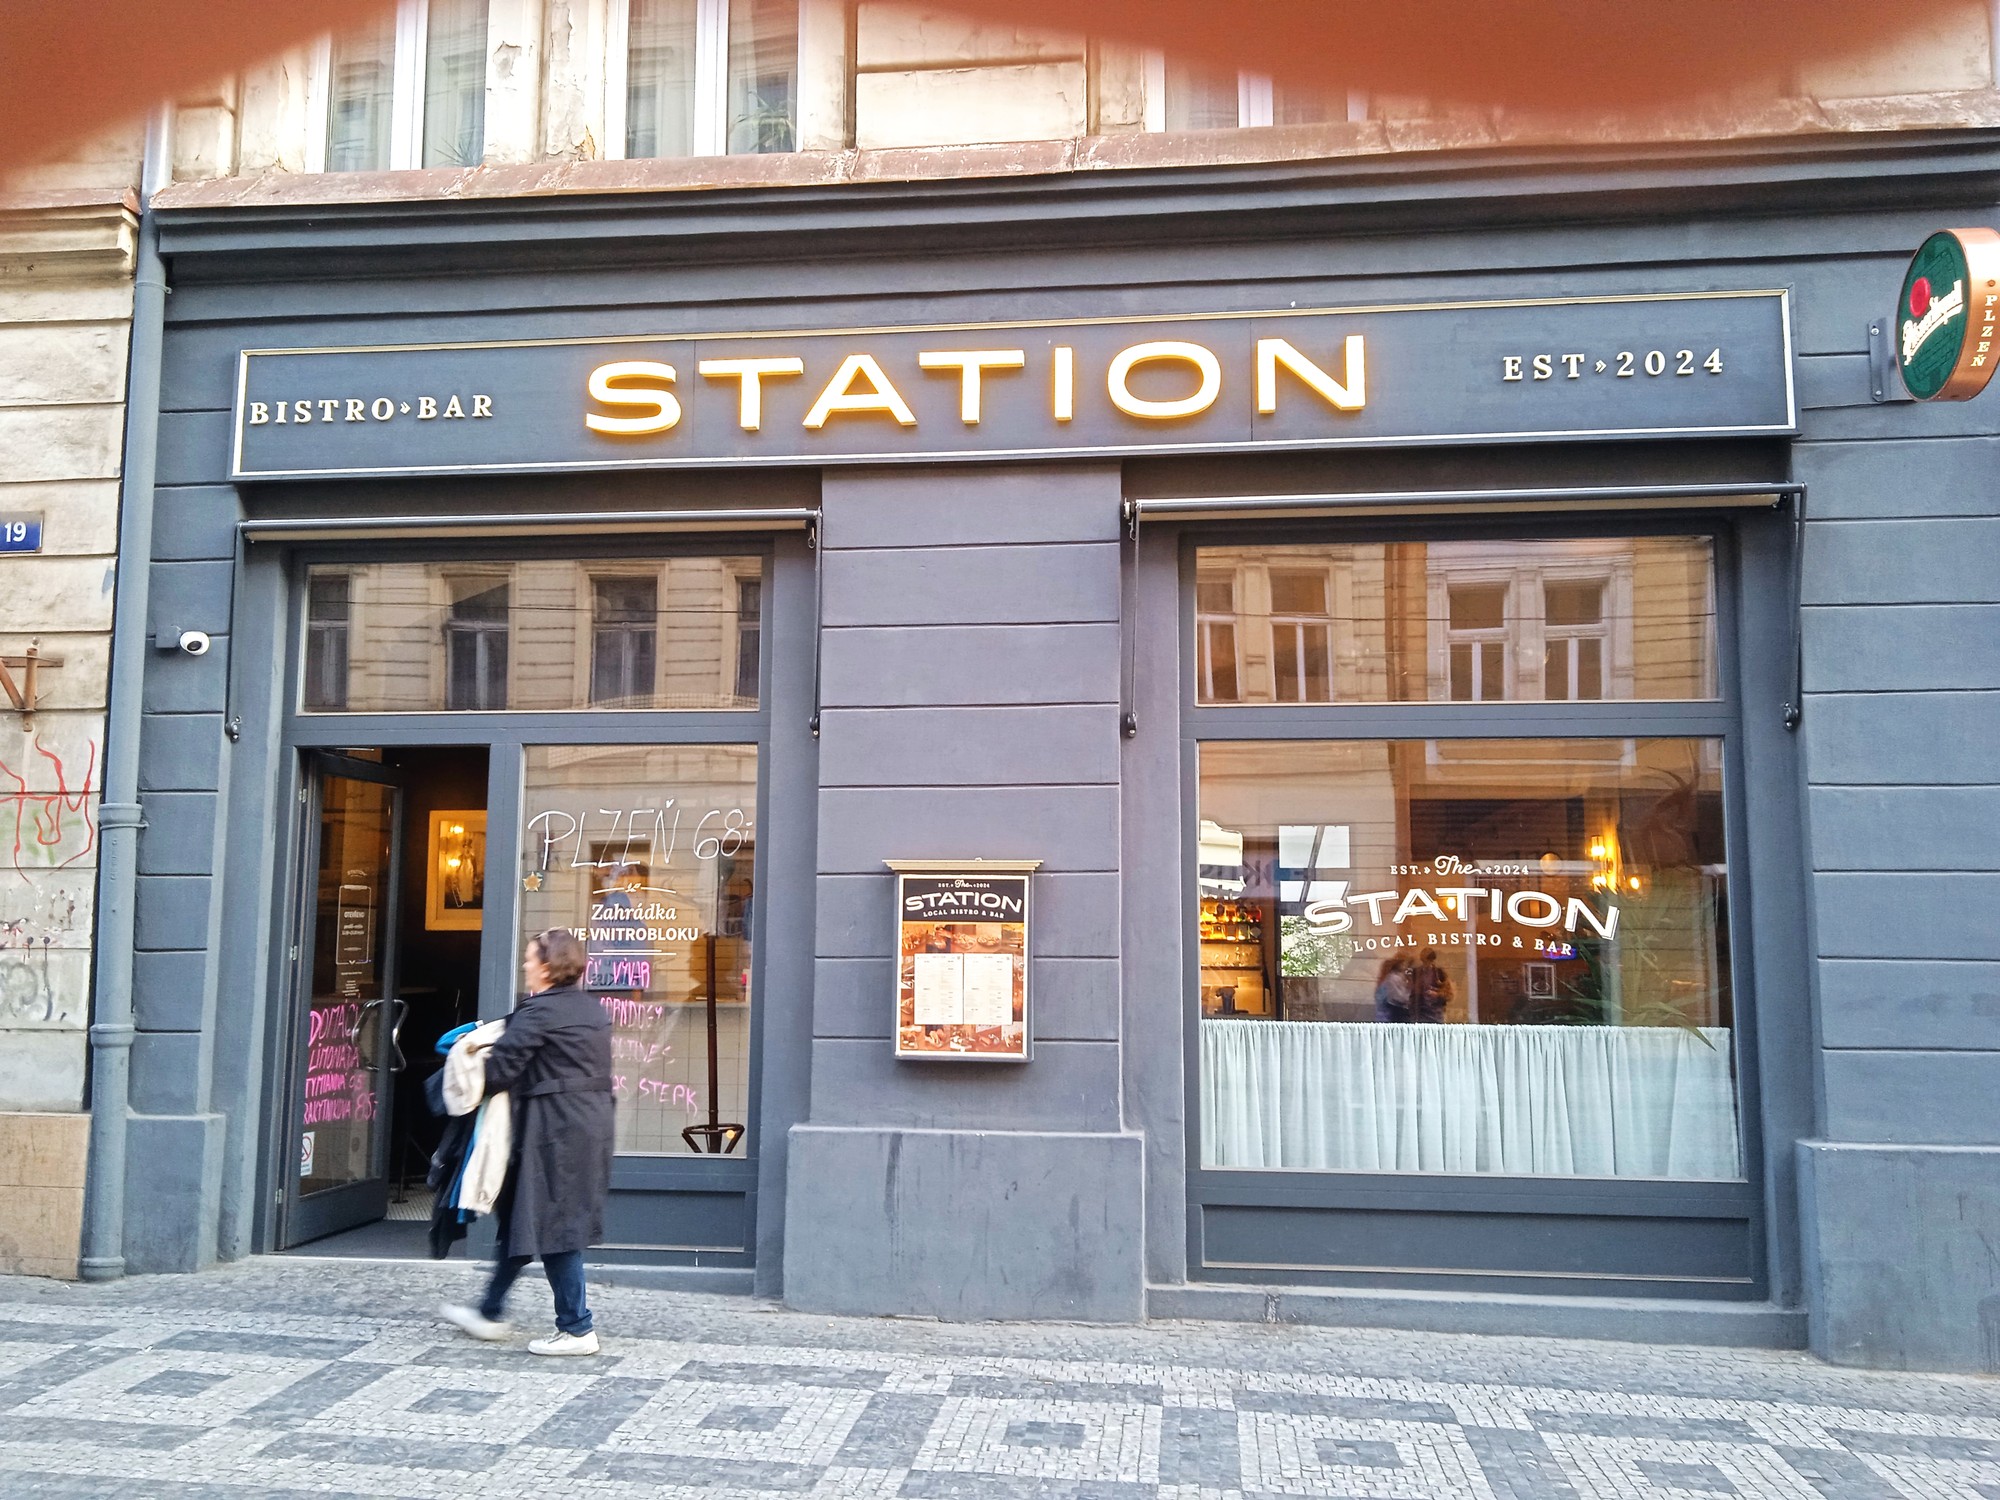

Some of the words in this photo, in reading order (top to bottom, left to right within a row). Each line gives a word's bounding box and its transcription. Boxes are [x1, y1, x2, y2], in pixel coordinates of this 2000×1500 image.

[1970, 294, 1998, 368] PLZEŇ
[1502, 353, 1586, 381] EST
[1615, 347, 1725, 378] 2024
[585, 334, 1366, 436] STATION
[249, 397, 395, 425] BISTRO
[417, 394, 494, 420] BAR
[4, 521, 27, 543] 19
[527, 798, 681, 871] PLZEŇ
[1389, 865, 1422, 876] EST.
[1434, 855, 1482, 876] The
[1493, 864, 1530, 876] 2024
[954, 879, 973, 889] The
[591, 902, 677, 921] Zahrádka
[905, 891, 1023, 914] STATION
[923, 909, 948, 917] LOCAL
[989, 911, 1005, 919] BAR
[1303, 887, 1621, 941] STATION
[589, 926, 699, 941] VNITROBLOKU
[1352, 933, 1418, 953] LOCAL
[1427, 932, 1503, 946] BISTRO
[1512, 935, 1524, 949] &
[1534, 938, 1573, 956] BAR
